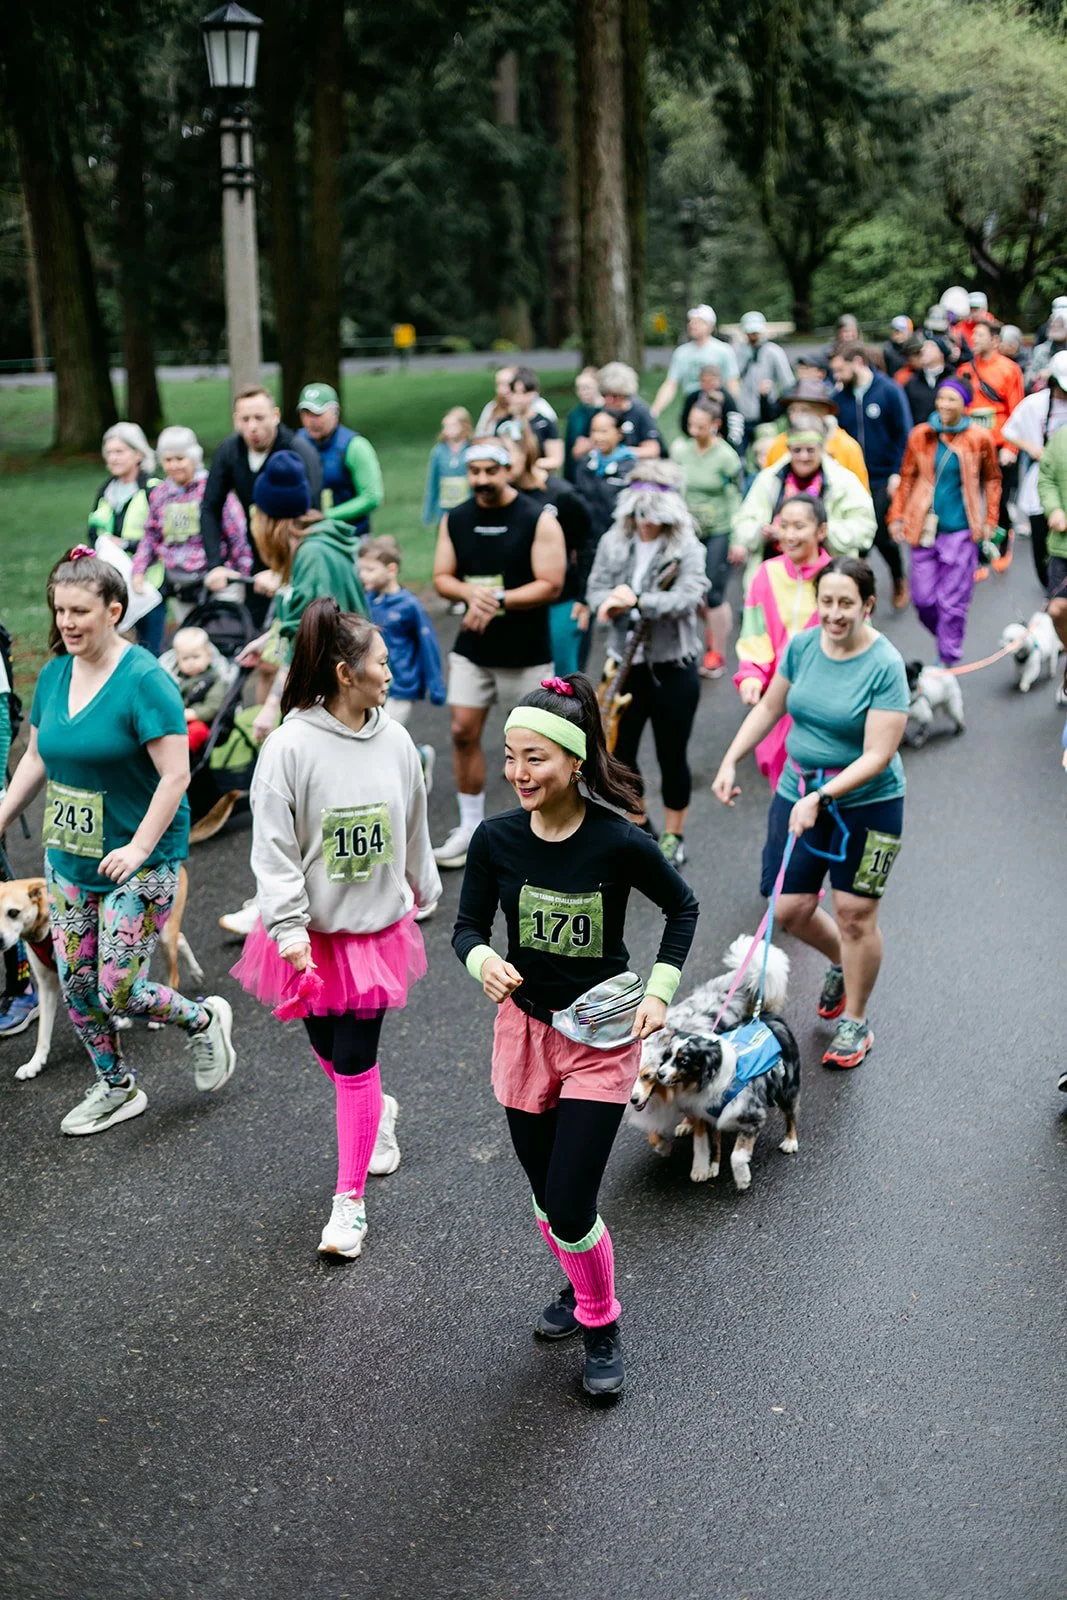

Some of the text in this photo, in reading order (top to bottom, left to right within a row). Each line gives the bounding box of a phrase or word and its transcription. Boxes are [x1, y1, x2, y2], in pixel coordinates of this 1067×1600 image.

[53, 799, 94, 835] 243
[333, 822, 385, 858] 164
[531, 909, 592, 948] 179
